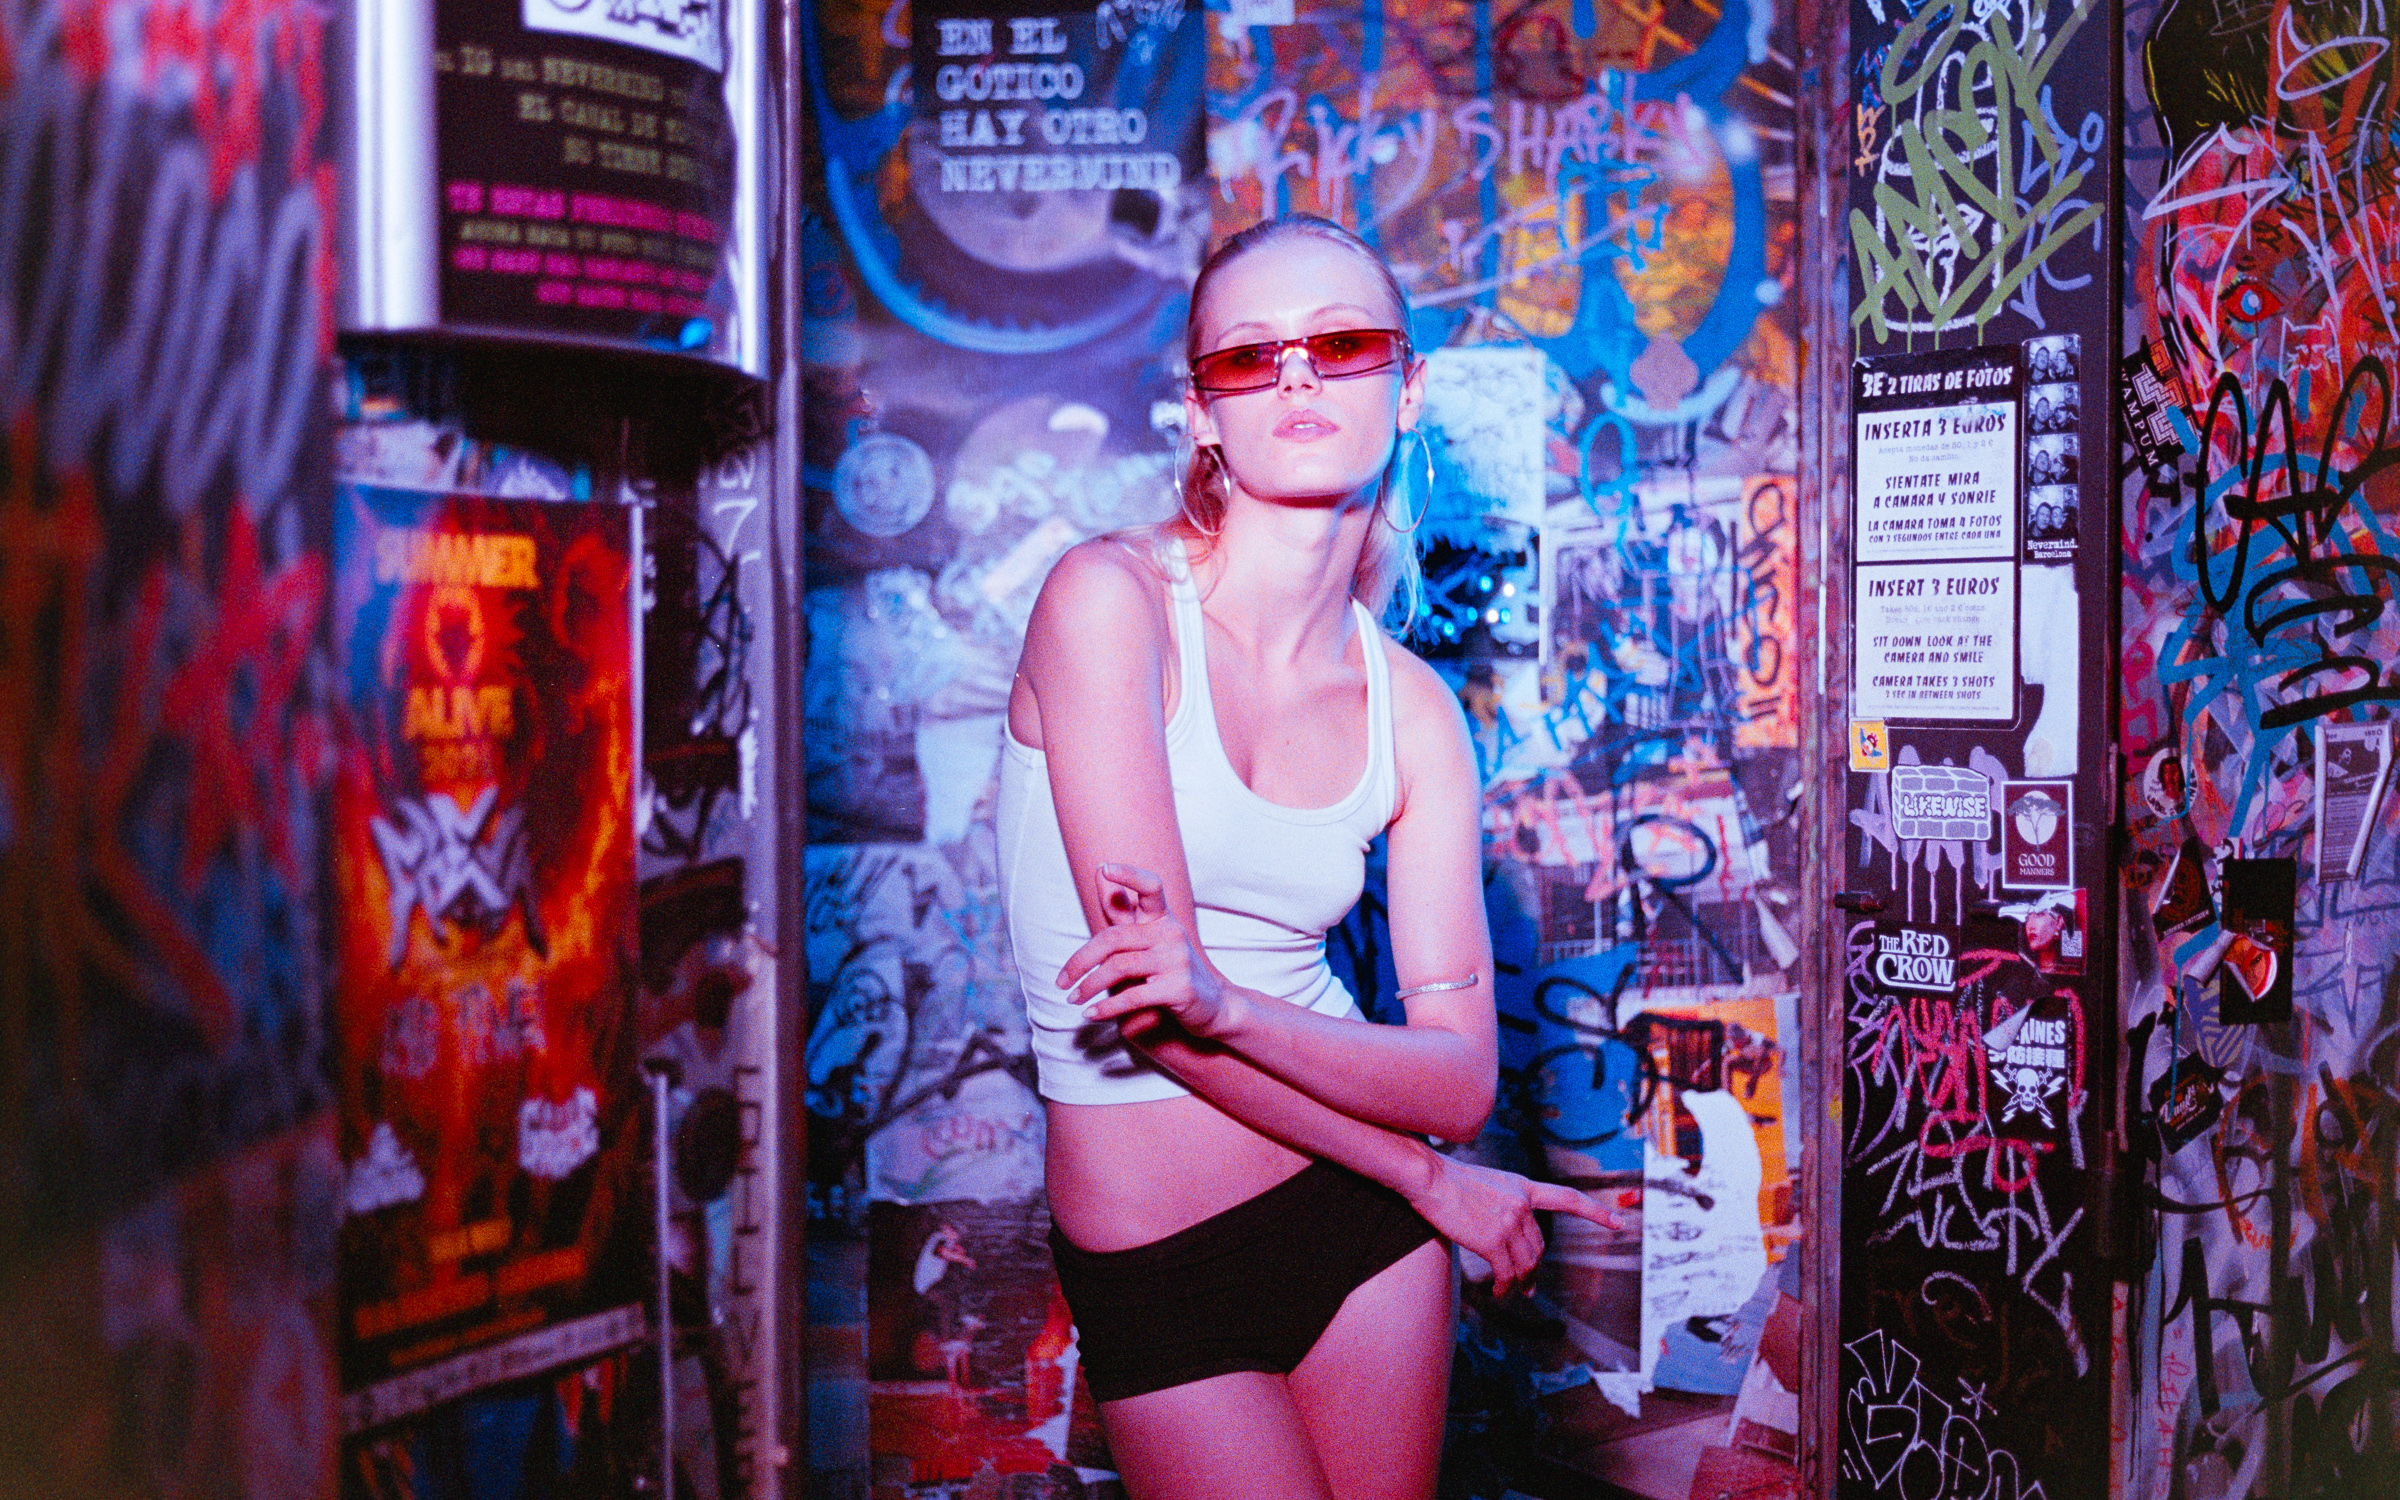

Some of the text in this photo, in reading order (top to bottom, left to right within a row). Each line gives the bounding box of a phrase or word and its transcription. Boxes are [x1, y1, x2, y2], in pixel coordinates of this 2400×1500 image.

[935, 18, 994, 56] EN
[1007, 16, 1068, 55] EL
[936, 63, 1085, 101] GOTICO
[939, 107, 1148, 147] HAY OTRO
[940, 152, 1182, 192] NEVERMIND
[1887, 377, 1897, 395] 2
[1900, 372, 1942, 394] TIRAS
[1944, 370, 1964, 390] DE
[1966, 366, 2013, 388] FOTOS
[1864, 413, 2007, 441] INSERTA 3 EUROS
[1885, 471, 1980, 490] SIENTATE MIRA
[1873, 489, 1996, 509] A CAMARA Y SONRIE
[1868, 520, 1879, 532] LA
[1882, 518, 1924, 532] CAMARA
[1927, 516, 1956, 530] TOMA
[1969, 514, 2002, 528] FOTOS
[1869, 534, 1884, 543] CON
[1893, 532, 1933, 543] SEGUNDOS
[1935, 531, 1959, 542] ENTRE
[1961, 530, 1982, 540] CADA
[1984, 529, 2001, 539] UNA
[2034, 550, 2072, 559] Barcelona
[1869, 576, 2000, 597] INSERT 3 EUROS
[1873, 635, 1888, 647] SIT
[1892, 635, 1922, 647] DOWN
[1927, 635, 1954, 647] LOOK
[1973, 634, 1993, 647] THE
[1884, 651, 1984, 663] CAMERA AND SMILE
[1872, 675, 1913, 687] CAMERA
[1916, 675, 1949, 687] TAKES
[1962, 675, 1995, 688] SHOTS
[1892, 690, 1906, 699] SEC
[1919, 690, 1954, 700] BETWEEN
[1956, 690, 1982, 700] SHOTS
[1902, 794, 1987, 819] LIKEWISE
[2018, 853, 2056, 867] GOOD
[2019, 867, 2055, 876] MANNERS
[1879, 929, 1950, 957] THE RED
[1876, 952, 1956, 991] CROW
